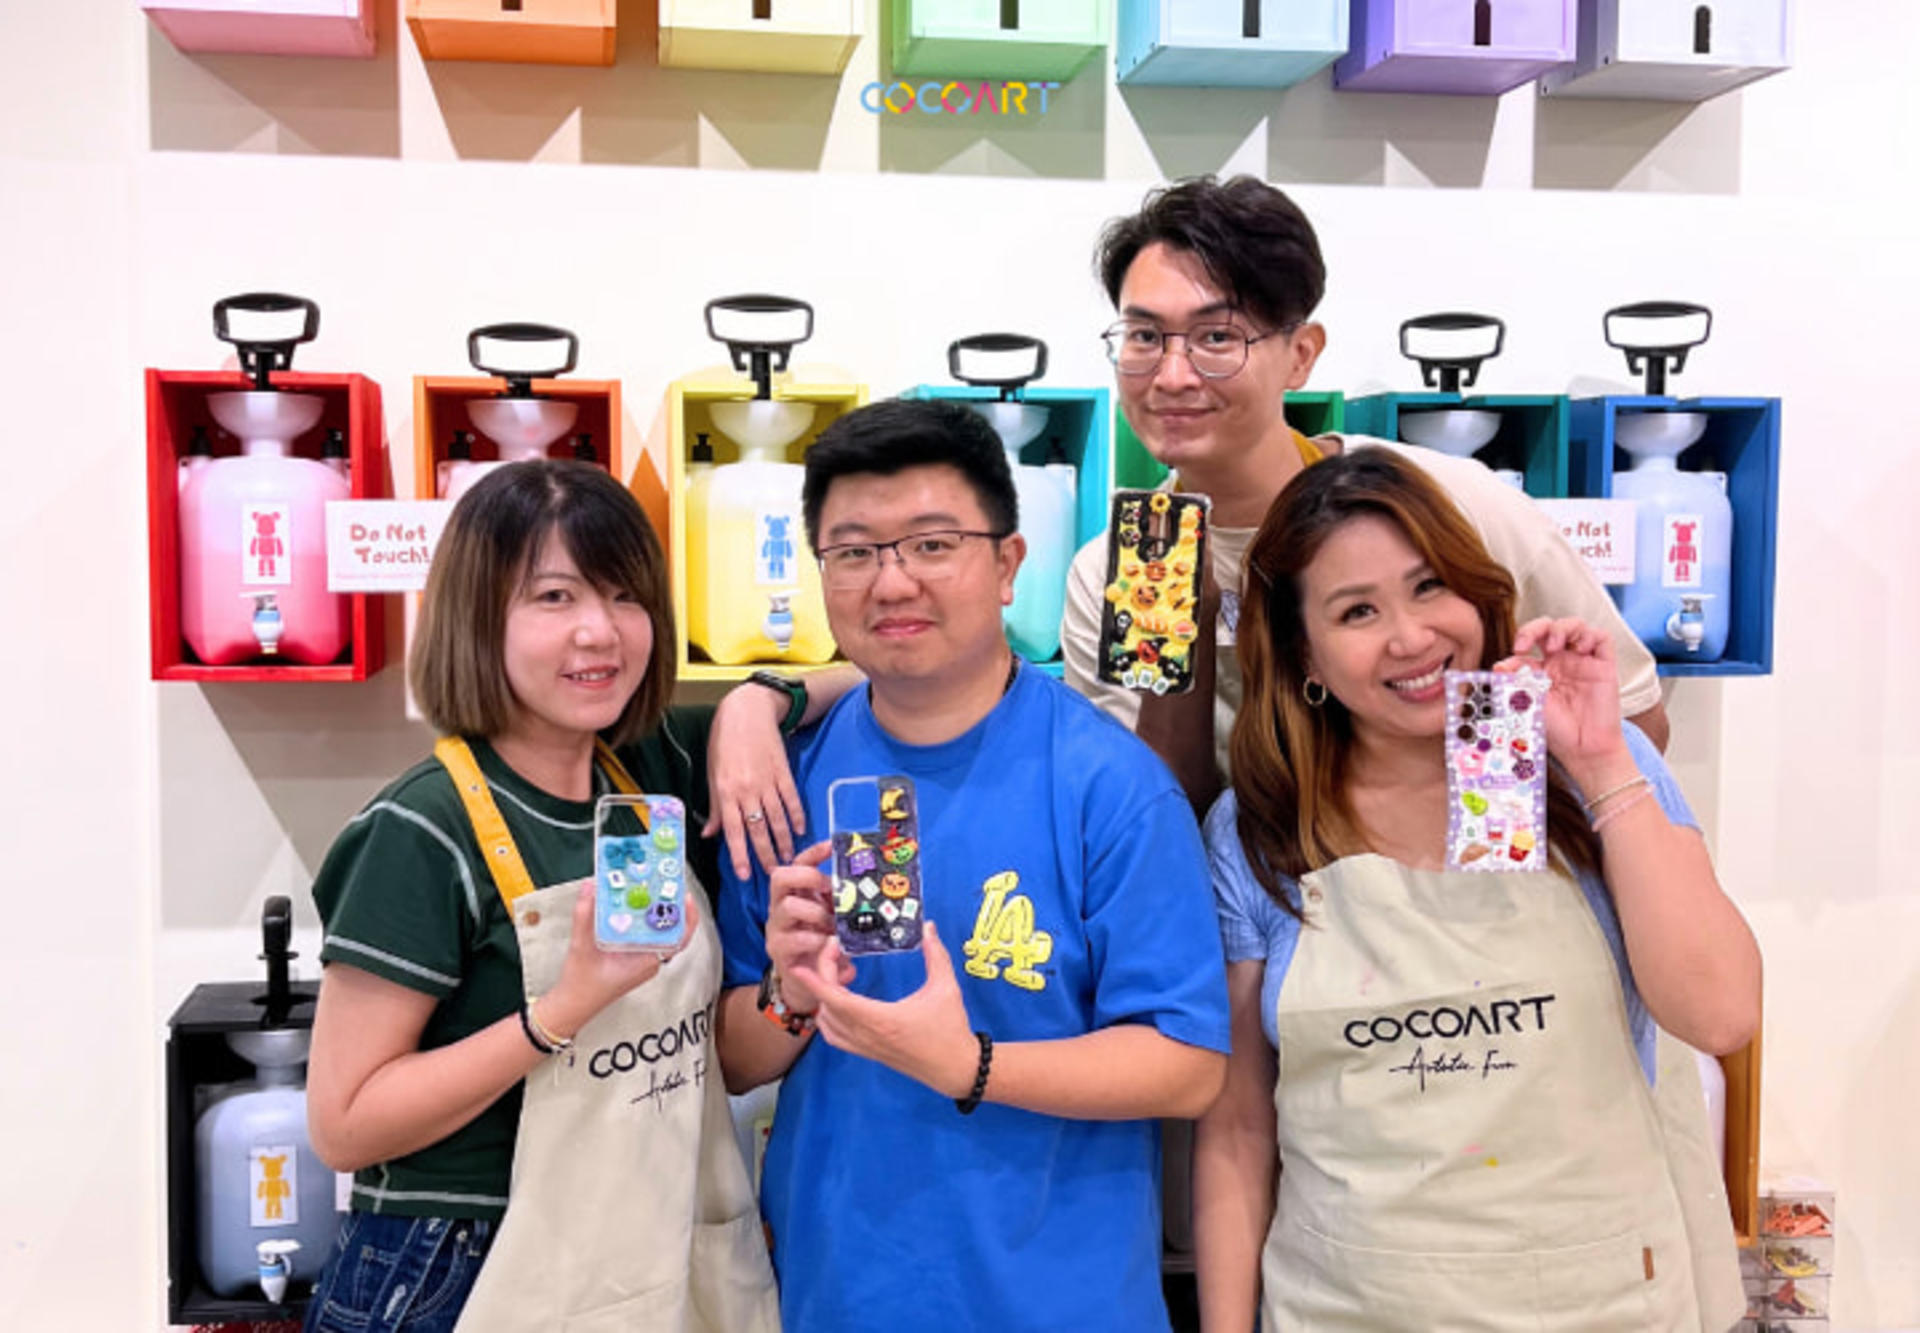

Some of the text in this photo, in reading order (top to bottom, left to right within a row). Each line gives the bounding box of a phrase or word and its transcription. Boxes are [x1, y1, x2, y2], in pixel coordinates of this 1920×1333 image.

[350, 522, 426, 541] Do Not
[1577, 521, 1610, 537] Not
[354, 546, 430, 563] Touch!
[963, 869, 1053, 991] LA
[1344, 994, 1555, 1048] COCOART
